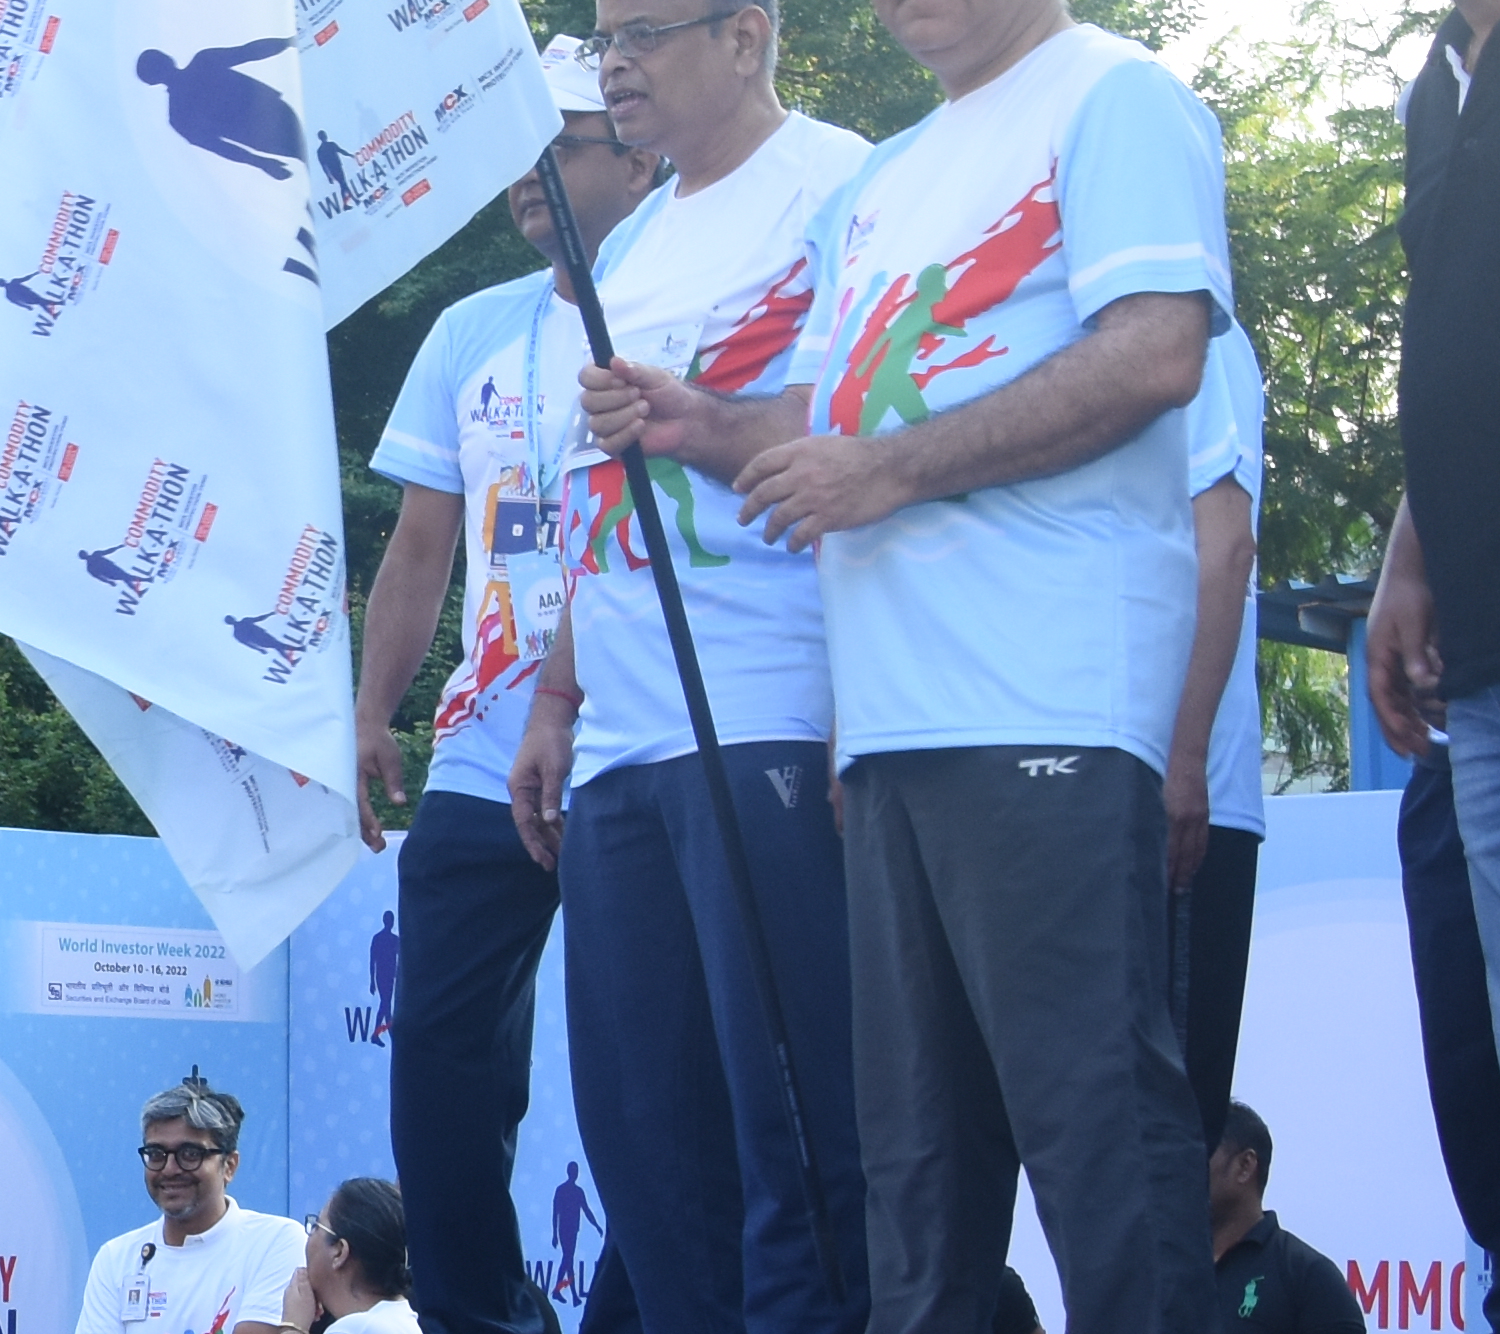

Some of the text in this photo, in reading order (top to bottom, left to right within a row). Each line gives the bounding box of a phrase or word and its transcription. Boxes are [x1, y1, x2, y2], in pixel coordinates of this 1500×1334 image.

[434, 84, 469, 124] MCX
[354, 110, 418, 168] COMMODITY
[39, 189, 76, 275] COMMODITY
[124, 456, 170, 549] COMMODITY
[275, 522, 321, 616] COMMODITY
[58, 937, 226, 959] World Investor Week 2022
[94, 962, 131, 974] October
[166, 966, 188, 977] 2022
